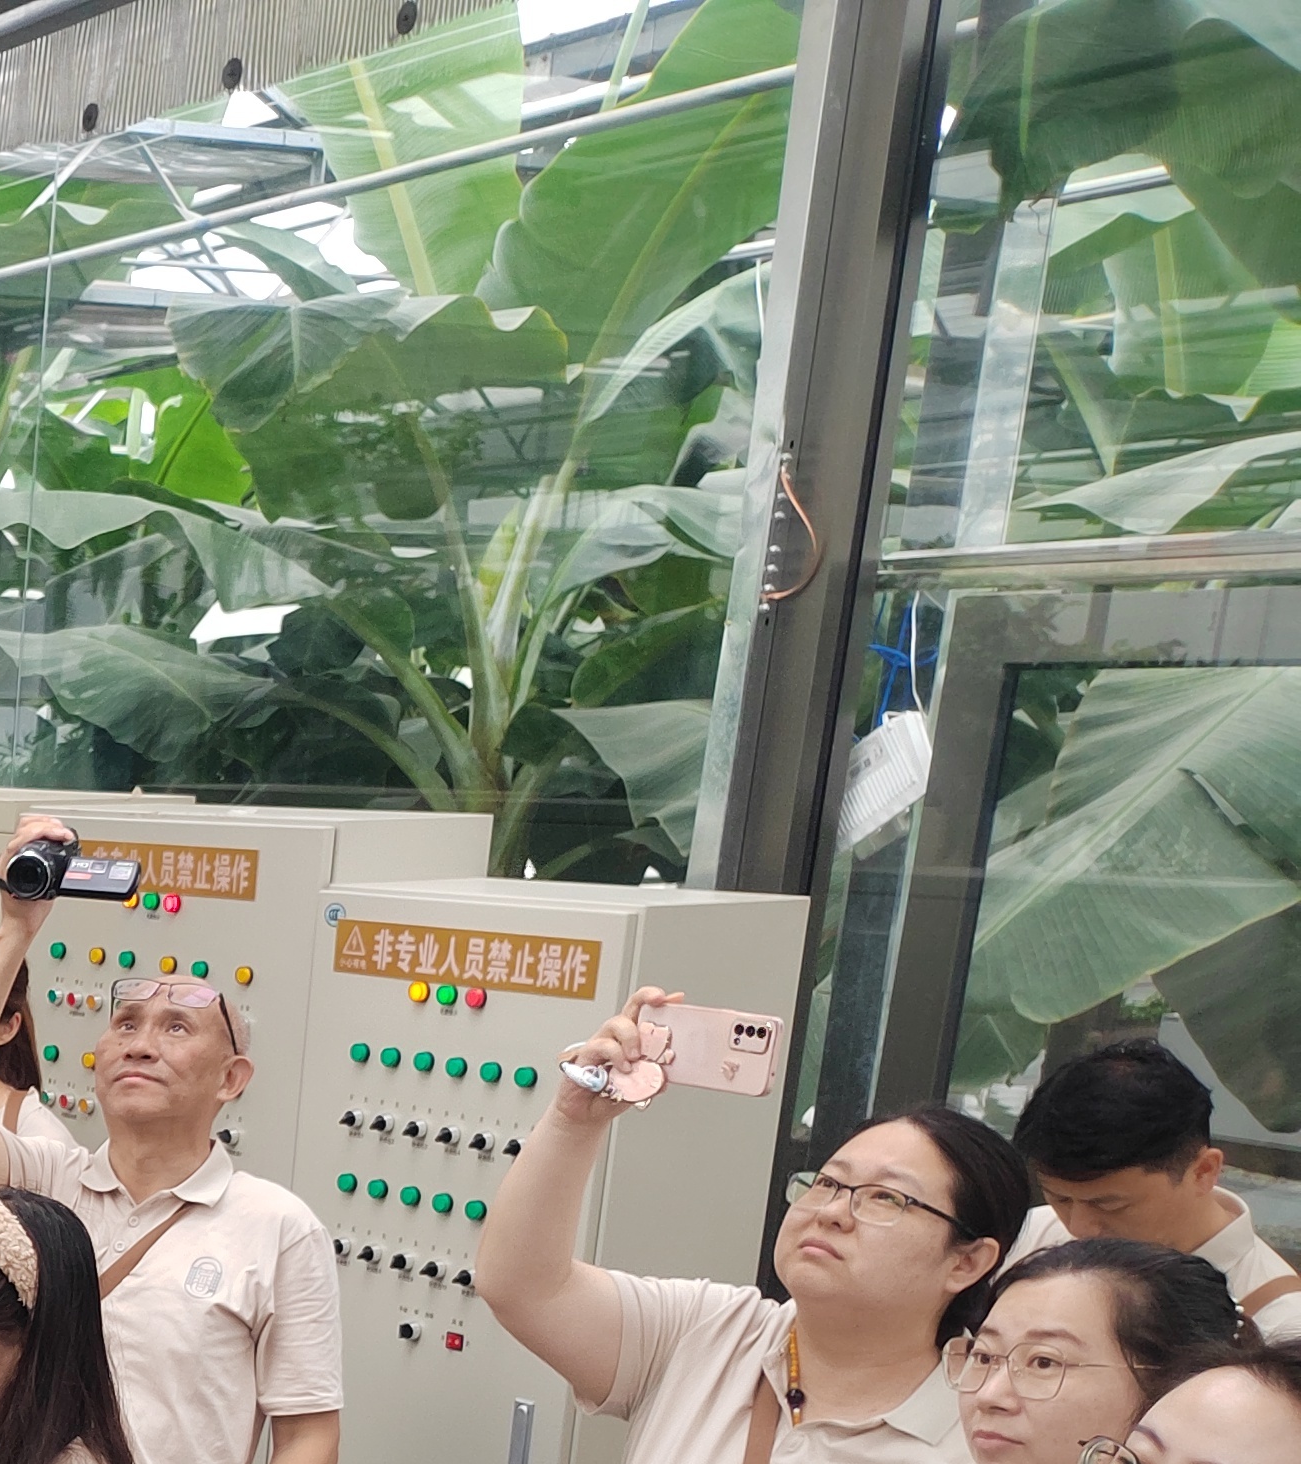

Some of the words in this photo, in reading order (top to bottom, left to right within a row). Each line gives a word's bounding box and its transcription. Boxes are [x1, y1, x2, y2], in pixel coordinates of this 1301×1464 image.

[371, 927, 590, 993] 非专业人员禁止操作
